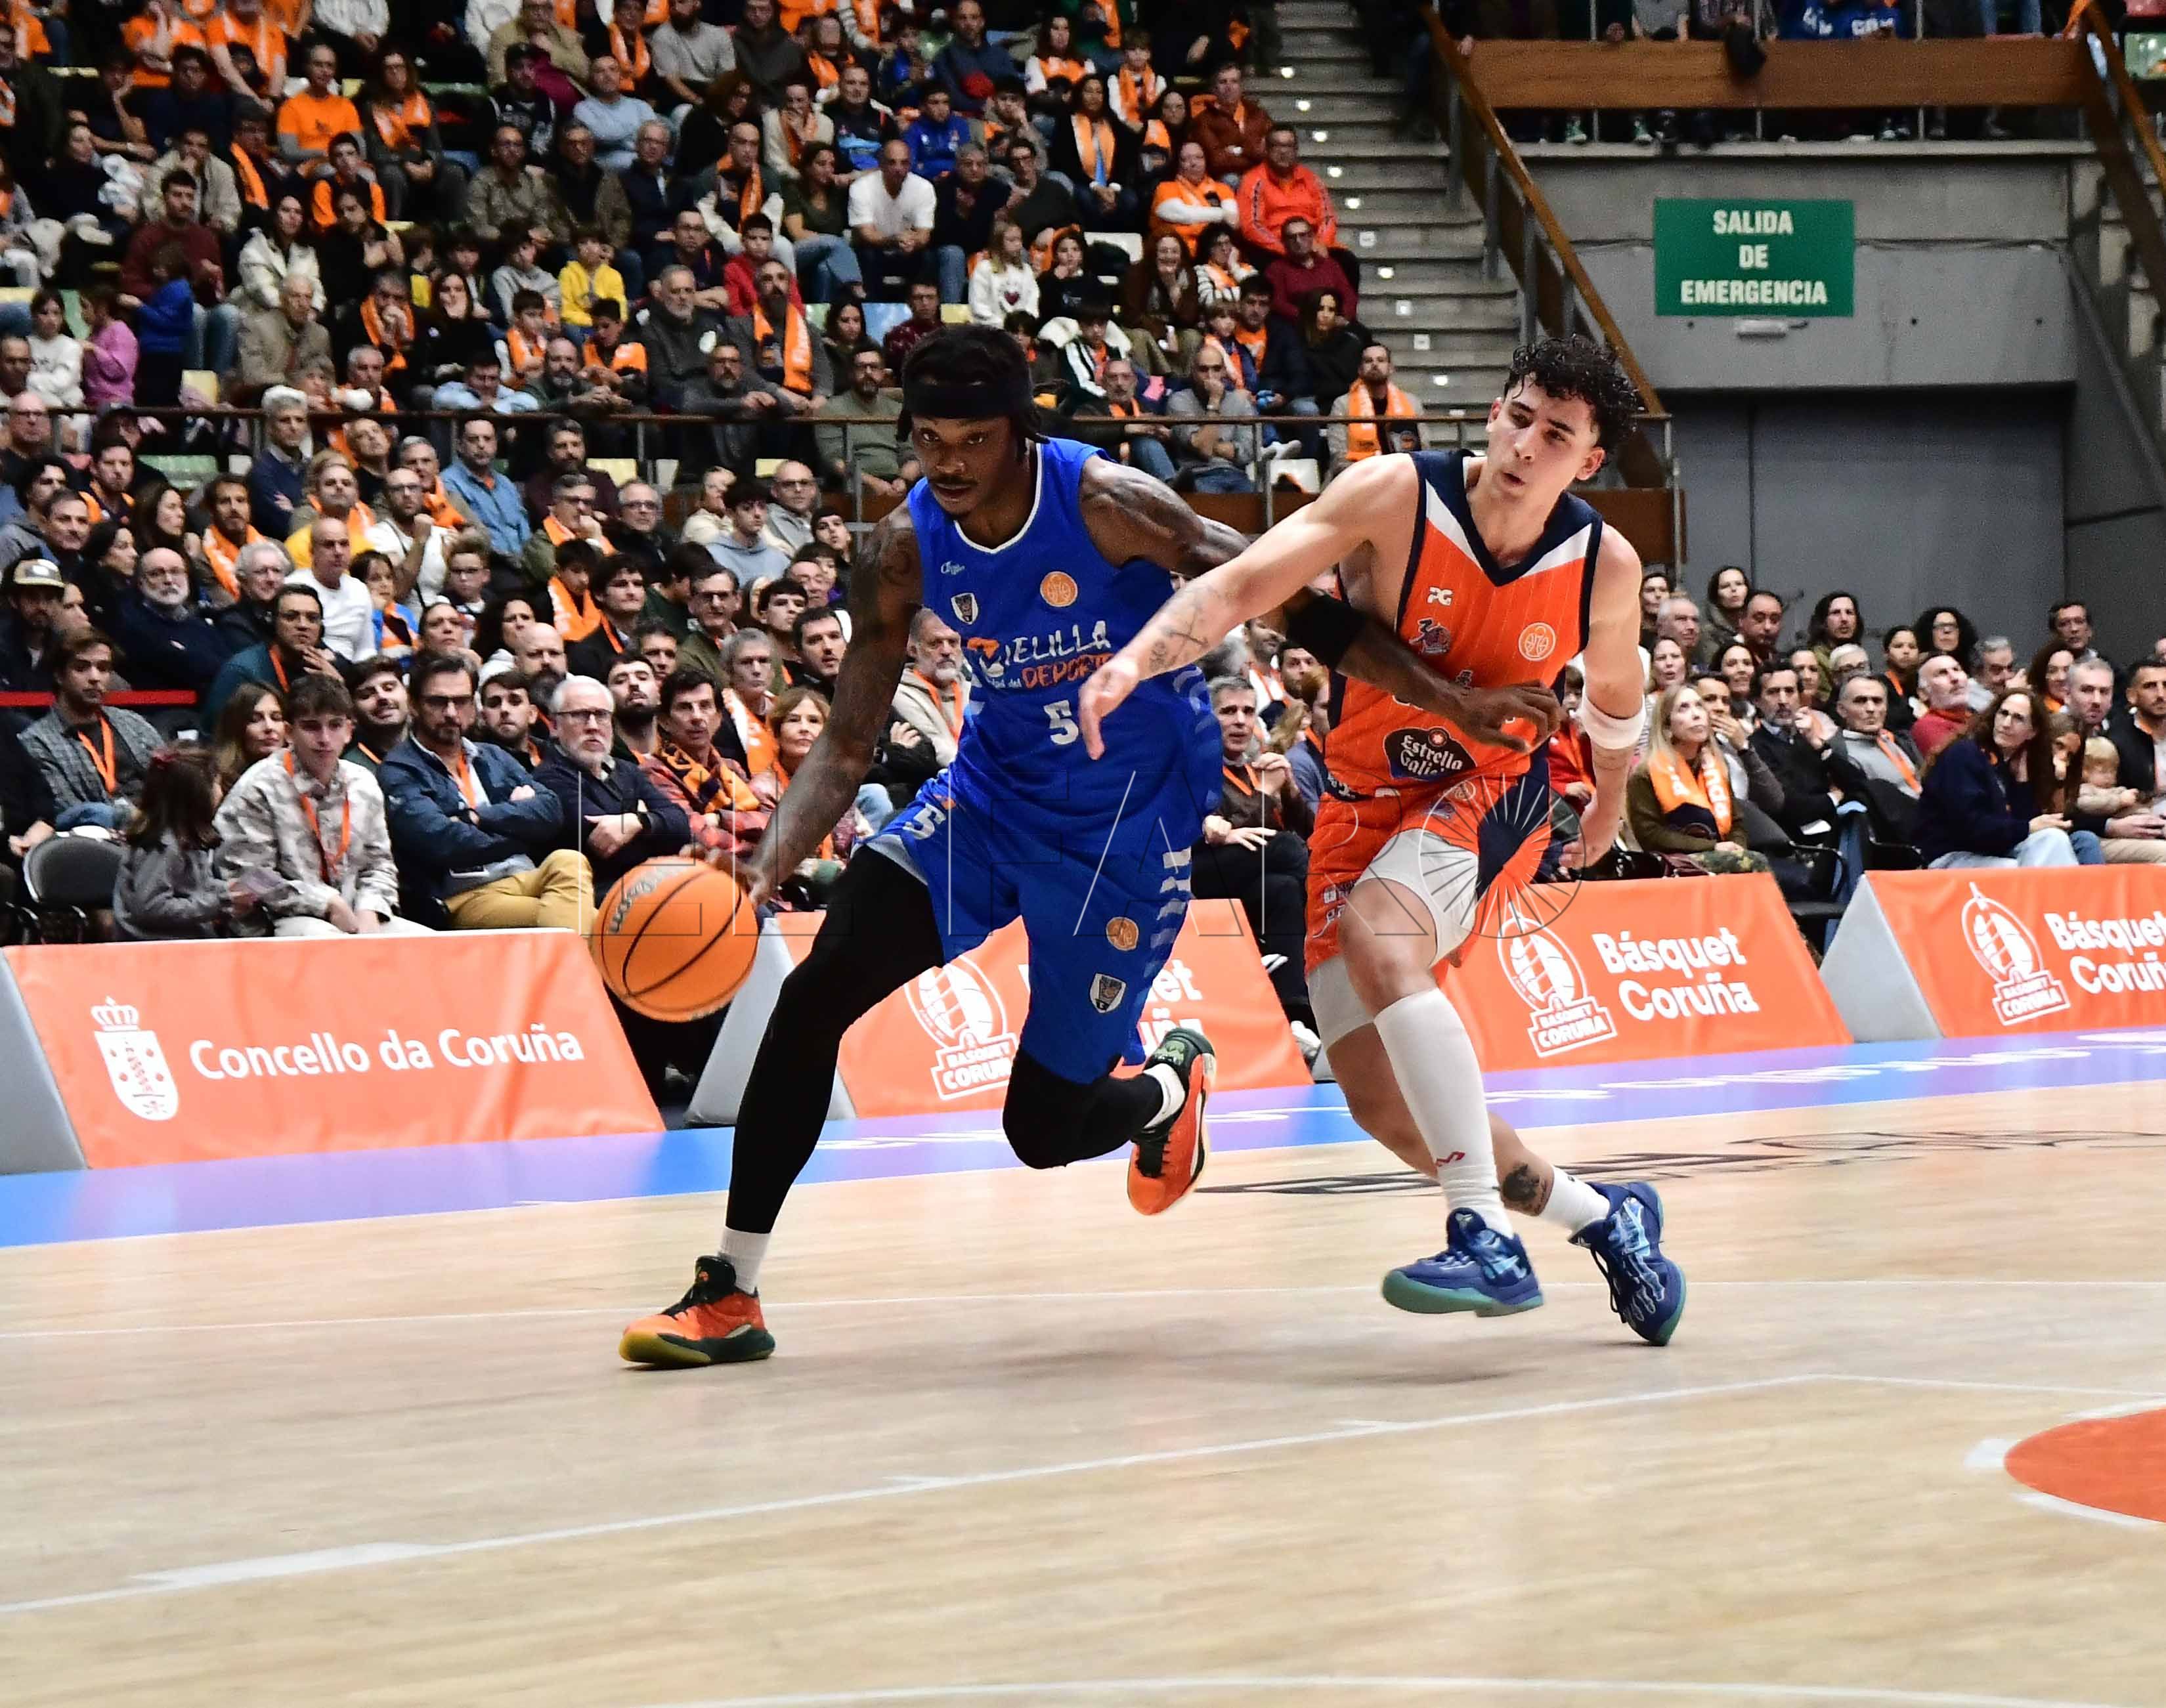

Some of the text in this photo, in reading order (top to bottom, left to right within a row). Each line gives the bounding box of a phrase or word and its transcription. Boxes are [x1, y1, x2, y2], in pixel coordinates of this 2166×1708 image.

[1713, 209, 1794, 234] SALIDA
[1739, 244, 1769, 269] DE
[1680, 280, 1828, 305] EMERGENCIA
[1043, 699, 1079, 745] 5
[1400, 735, 1463, 770] Estrella
[902, 802, 946, 840] 5
[1592, 926, 1748, 979] Básquet
[2069, 950, 2166, 994] Coruñ
[1618, 971, 1760, 1021] Coruña
[189, 1022, 585, 1080] Concello da Coruña
